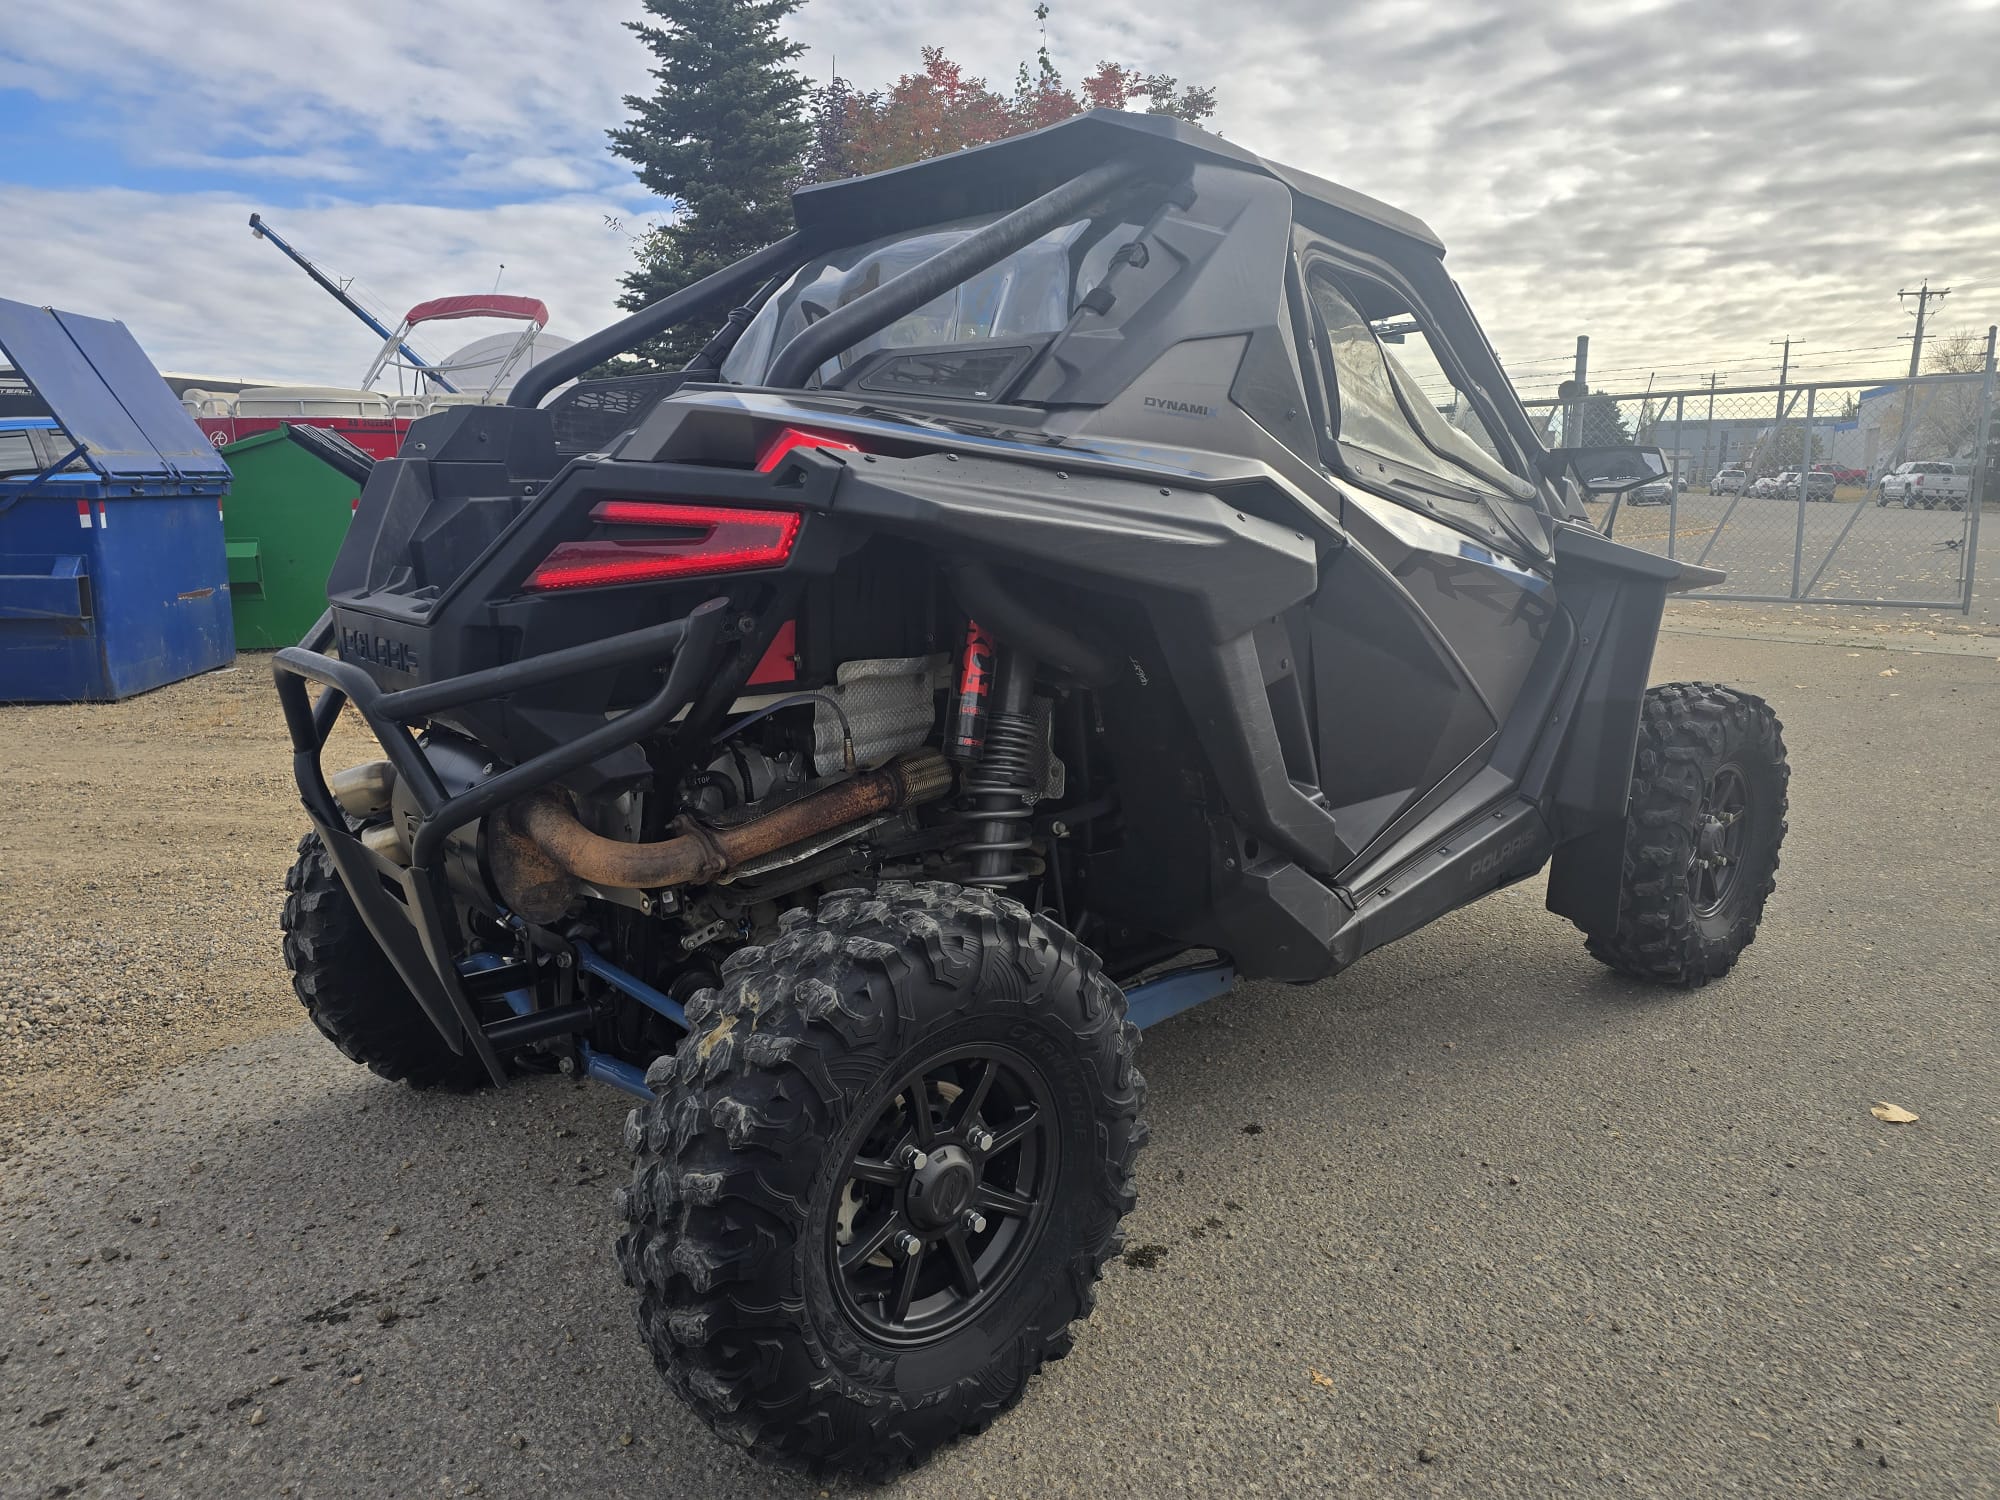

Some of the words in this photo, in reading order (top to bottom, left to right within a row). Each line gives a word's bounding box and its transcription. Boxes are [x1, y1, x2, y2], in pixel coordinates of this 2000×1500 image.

[342, 626, 419, 676] POLARIS
[960, 618, 993, 697] FOX
[1469, 830, 1538, 881] POLARIS
